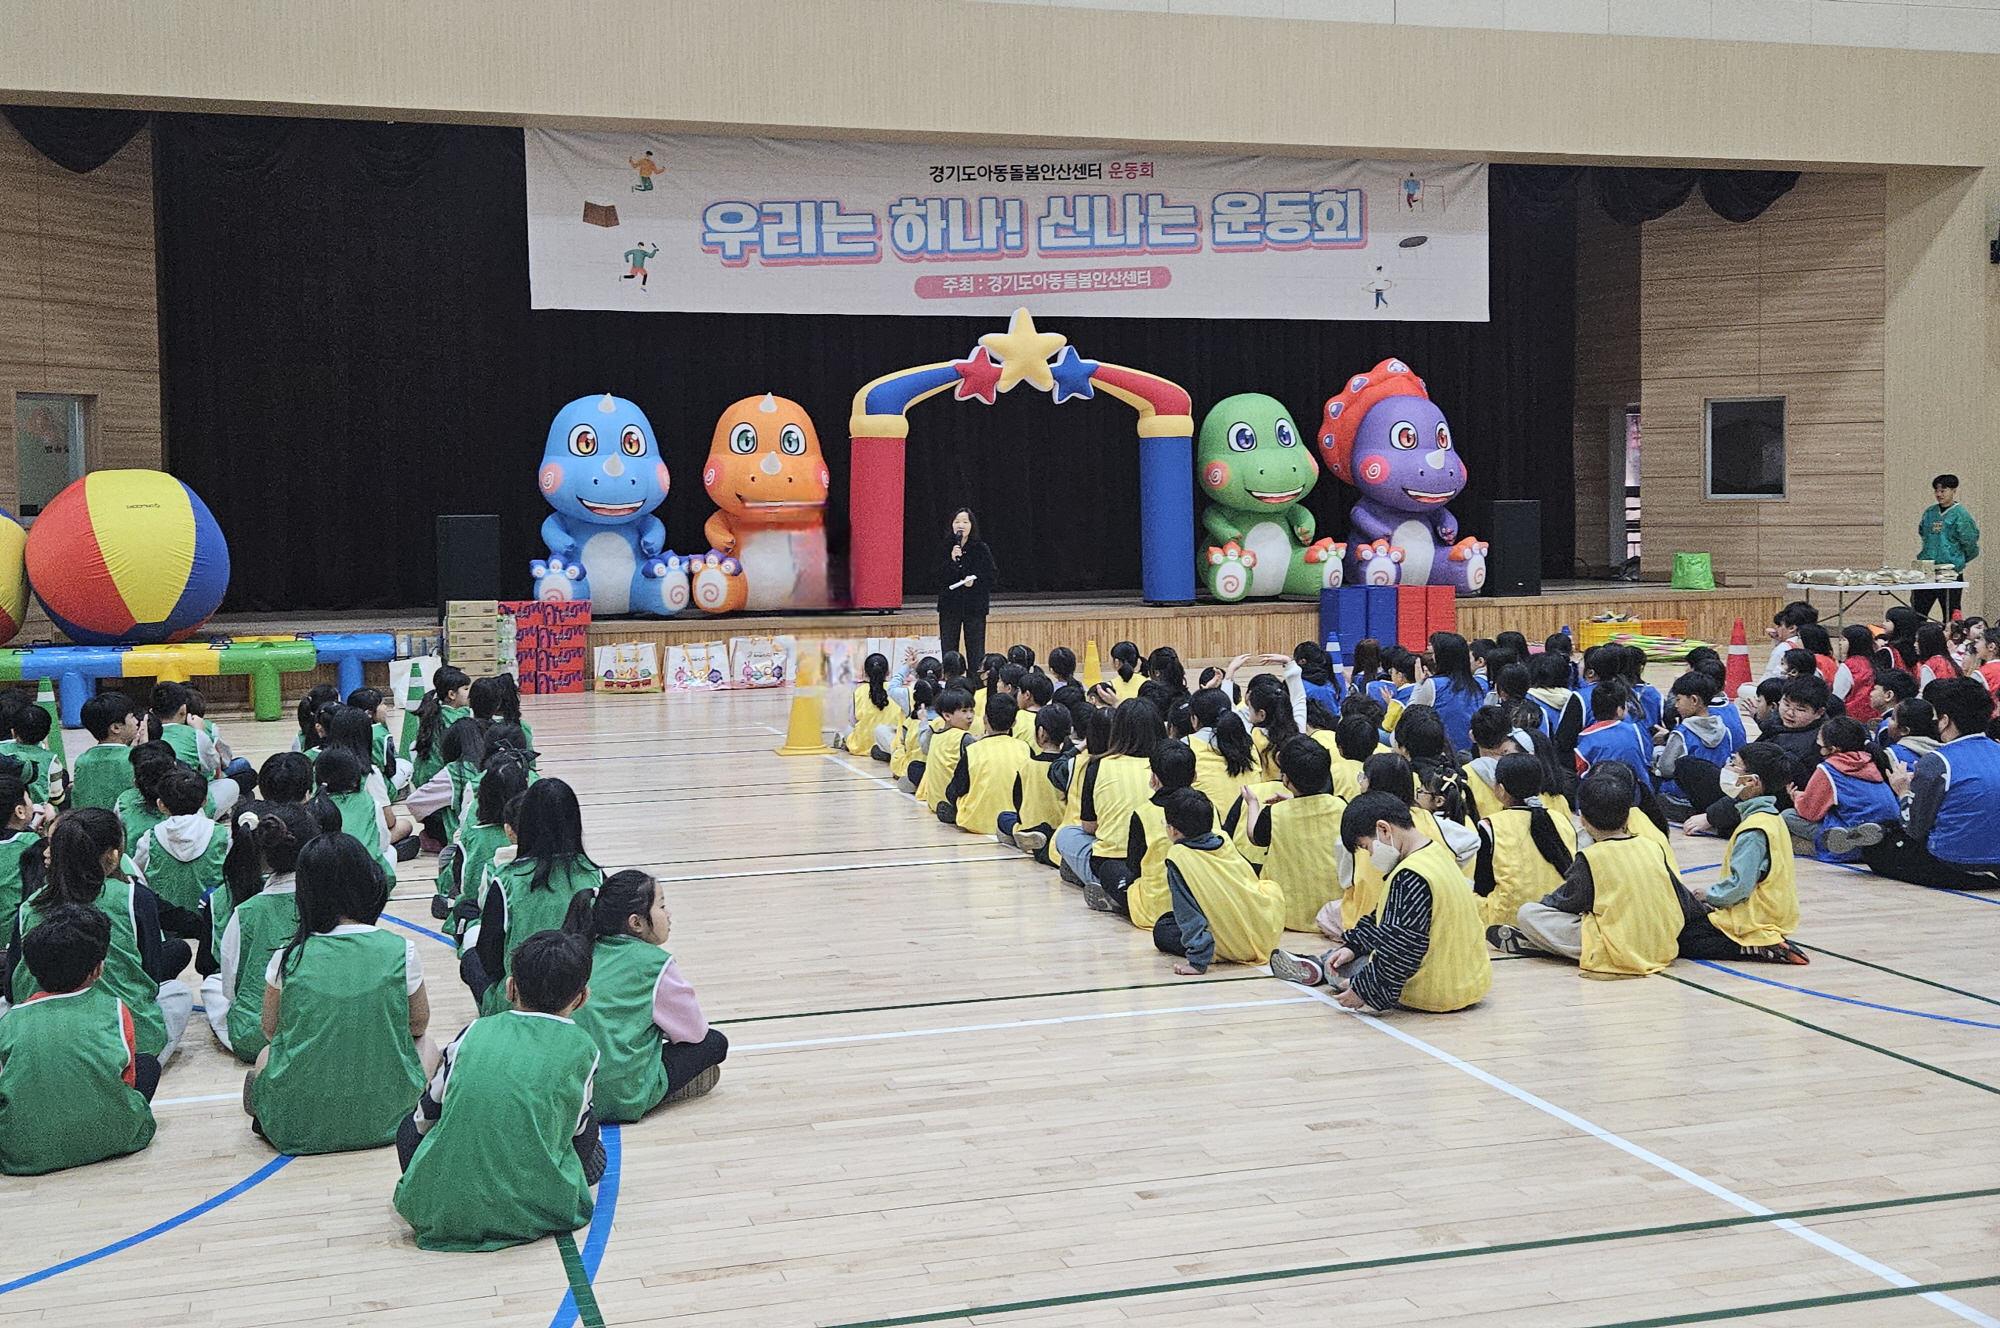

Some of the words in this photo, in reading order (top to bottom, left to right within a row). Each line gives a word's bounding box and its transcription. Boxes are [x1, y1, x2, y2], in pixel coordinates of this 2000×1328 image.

[929, 164, 1102, 183] 경기도아동돌봄안산센터
[1108, 161, 1154, 180] 운동회
[702, 199, 879, 263] 우리는
[888, 196, 1025, 259] 하나!
[1037, 193, 1199, 253] 신나는
[1211, 189, 1364, 248] 운동회
[942, 276, 974, 294] 주최
[987, 270, 1151, 293] 경기도아동돌봄안산센터
